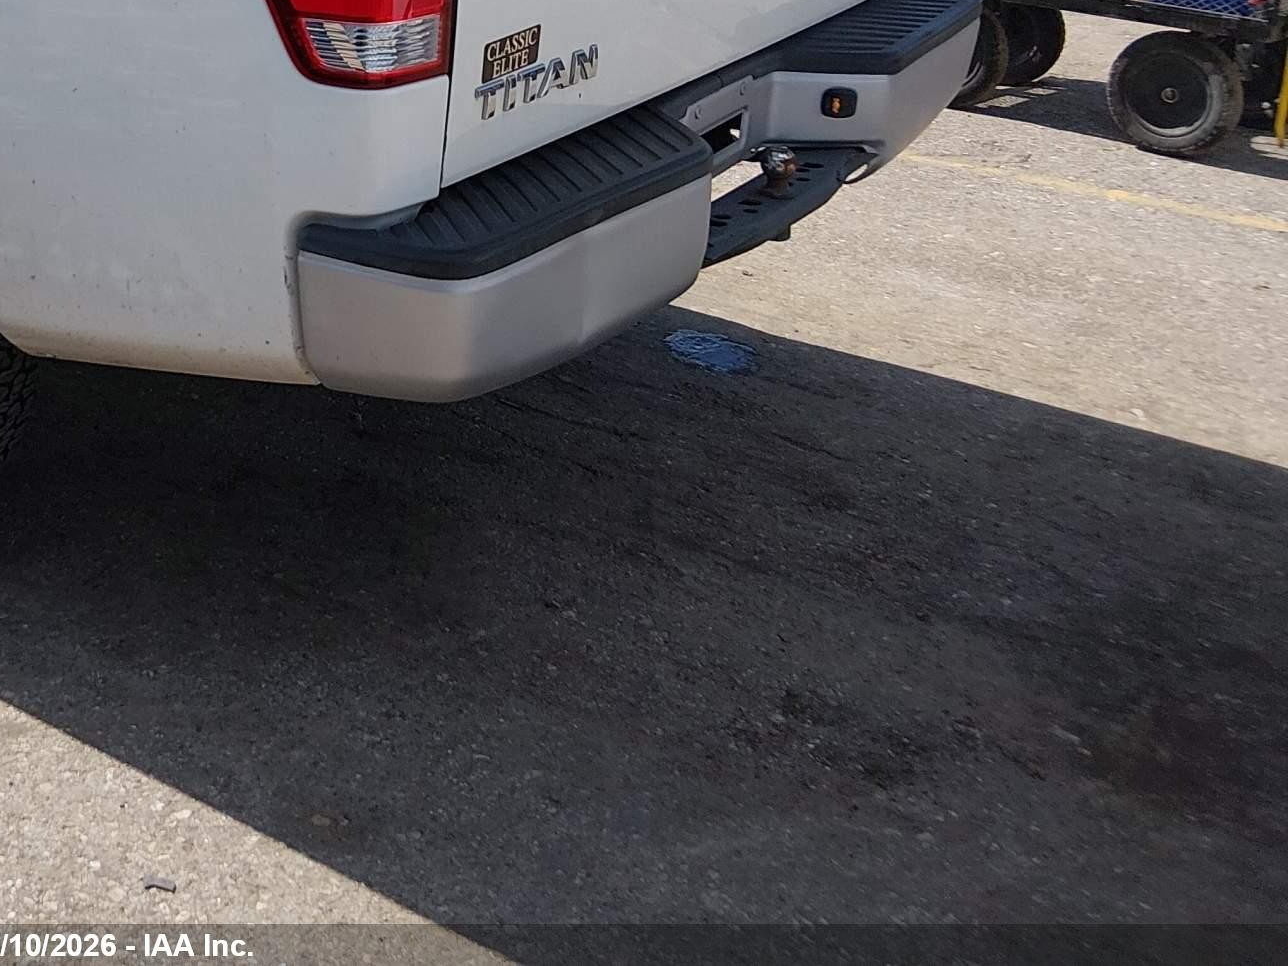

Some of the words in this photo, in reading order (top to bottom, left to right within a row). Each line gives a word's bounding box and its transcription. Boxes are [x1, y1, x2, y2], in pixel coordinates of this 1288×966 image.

[487, 27, 538, 61] CLASSIC
[492, 49, 529, 79] ELITE
[475, 43, 598, 121] TITAN
